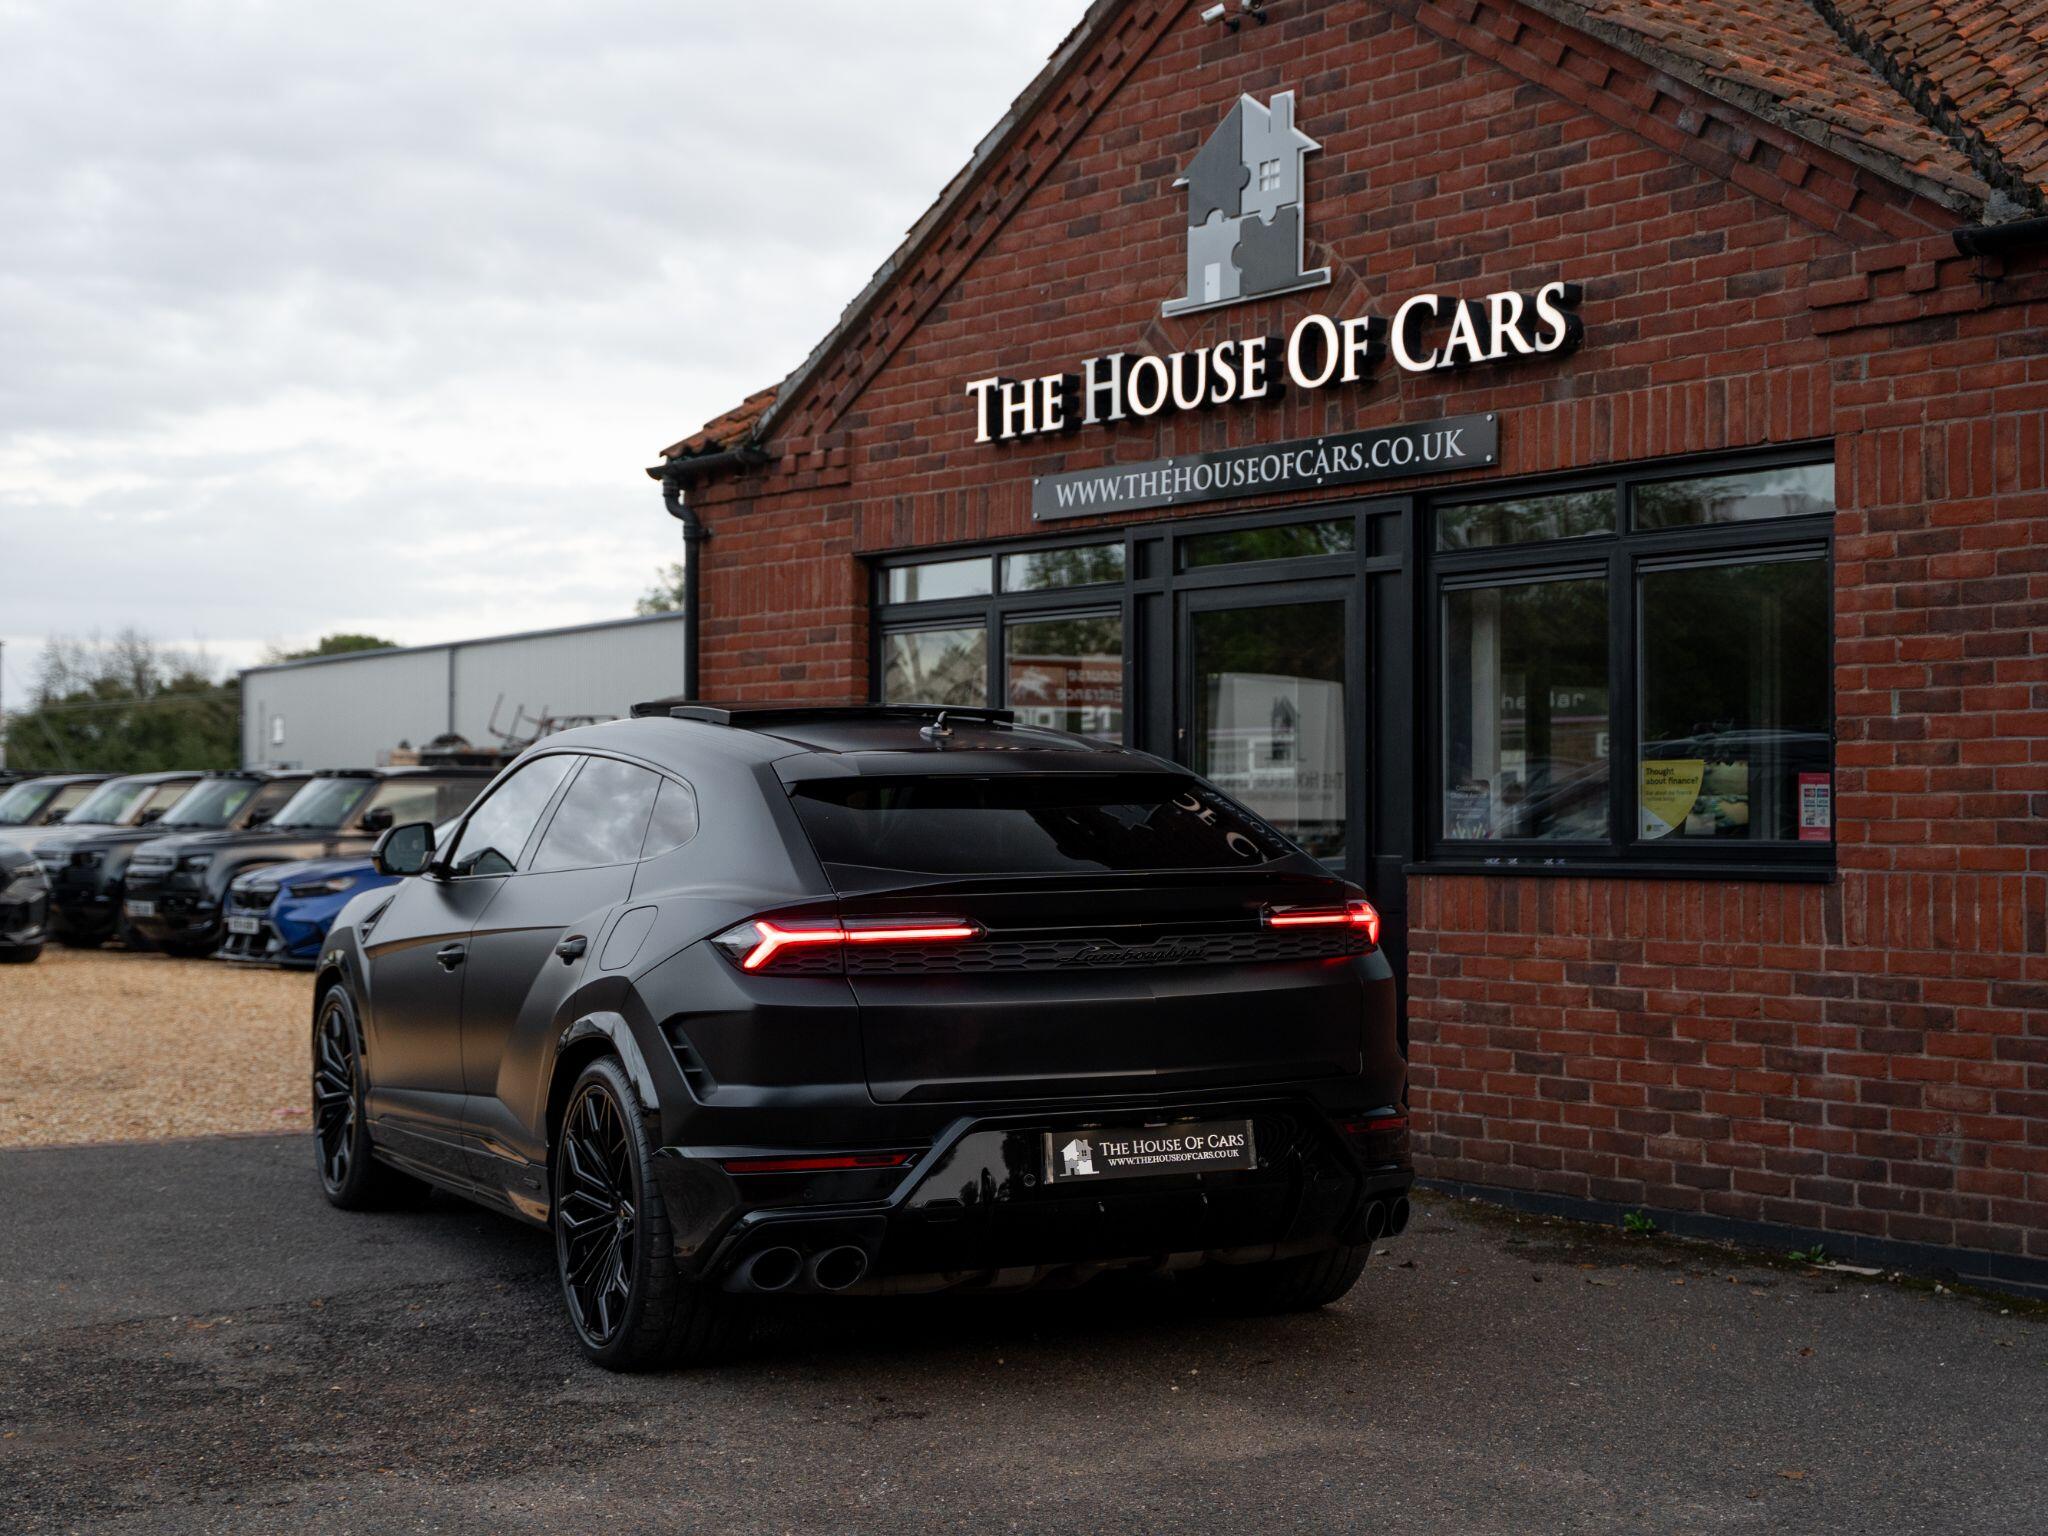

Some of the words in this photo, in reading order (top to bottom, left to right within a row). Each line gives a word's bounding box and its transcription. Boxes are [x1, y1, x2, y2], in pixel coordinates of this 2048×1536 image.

[966, 374, 1065, 443] THE
[1082, 336, 1268, 425] HOUSE
[1288, 313, 1370, 390] OF
[1391, 281, 1567, 372] CARS
[1055, 429, 1466, 509] WWW.THEHOUSEOFCARS.CO.UK
[1646, 768, 1674, 776] Thought
[1668, 777, 1699, 785] finance?
[1099, 1141, 1130, 1156] THE
[1133, 1138, 1182, 1154] HOUSE
[1185, 1136, 1204, 1150] OF
[1207, 1134, 1244, 1148] CARS
